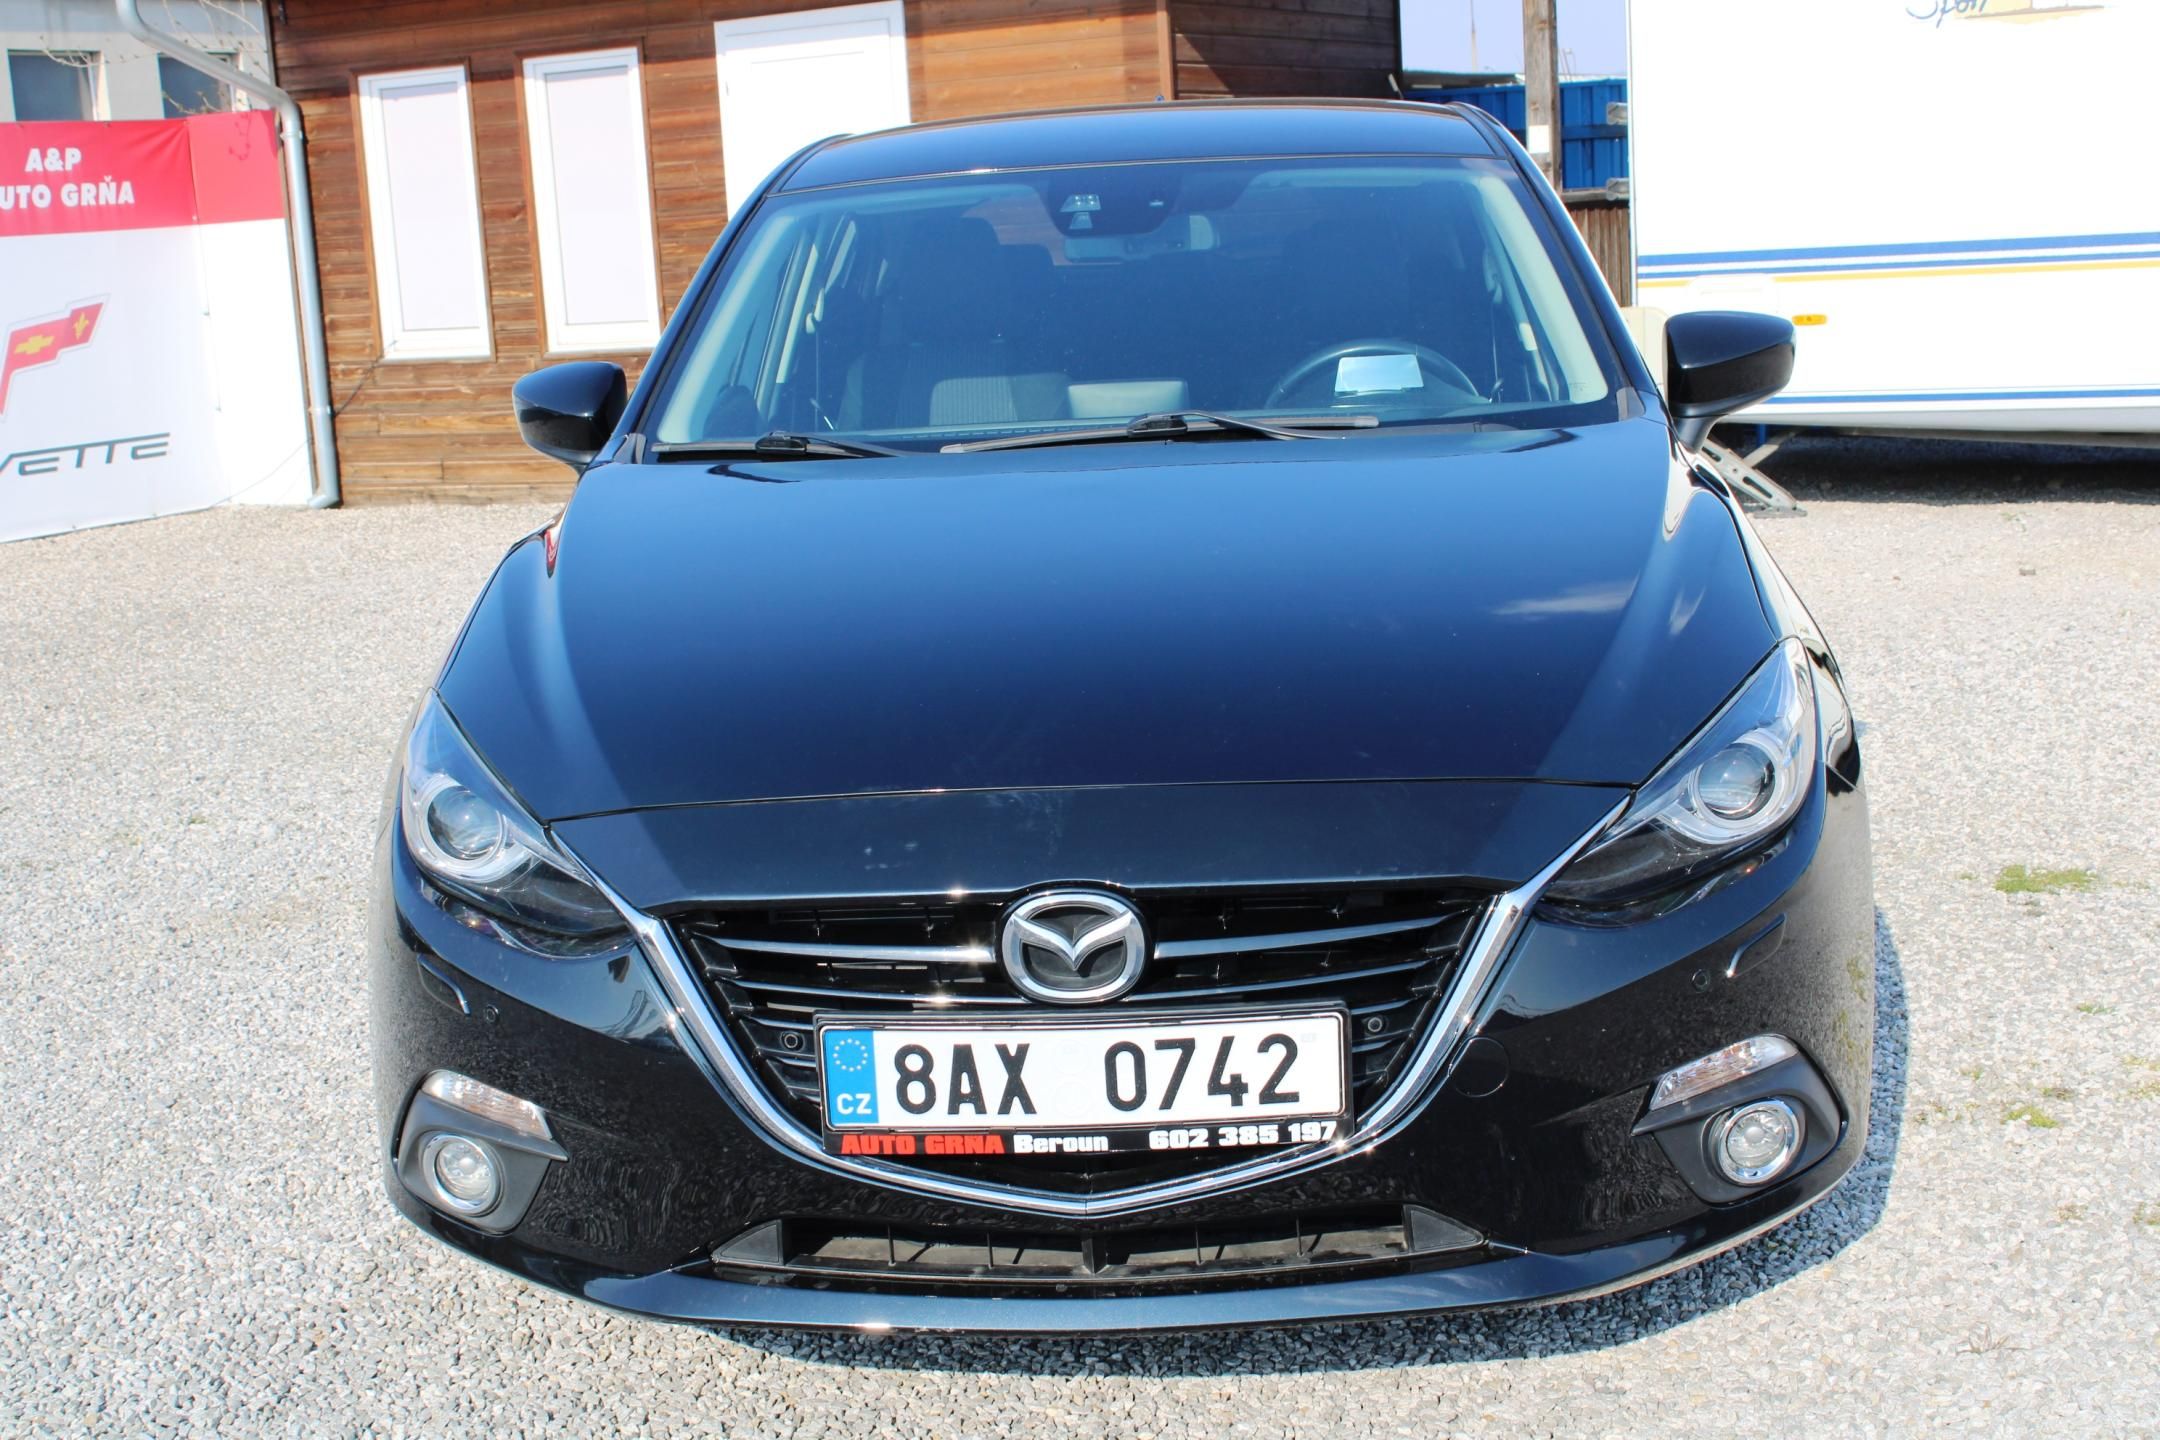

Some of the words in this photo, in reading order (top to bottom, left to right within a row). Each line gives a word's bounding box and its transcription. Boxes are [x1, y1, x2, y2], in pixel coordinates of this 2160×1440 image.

[25, 147, 82, 172] A&P
[61, 175, 136, 207] GRŇA
[894, 1043, 1037, 1115] 8AX
[1104, 1033, 1300, 1113] 0742
[837, 1093, 872, 1115] CZ
[841, 1134, 916, 1155] AUTO
[1013, 1135, 1109, 1153] Beroun
[1149, 1128, 1209, 1149] 602
[1218, 1124, 1279, 1146] 385
[1287, 1120, 1338, 1143] 197
